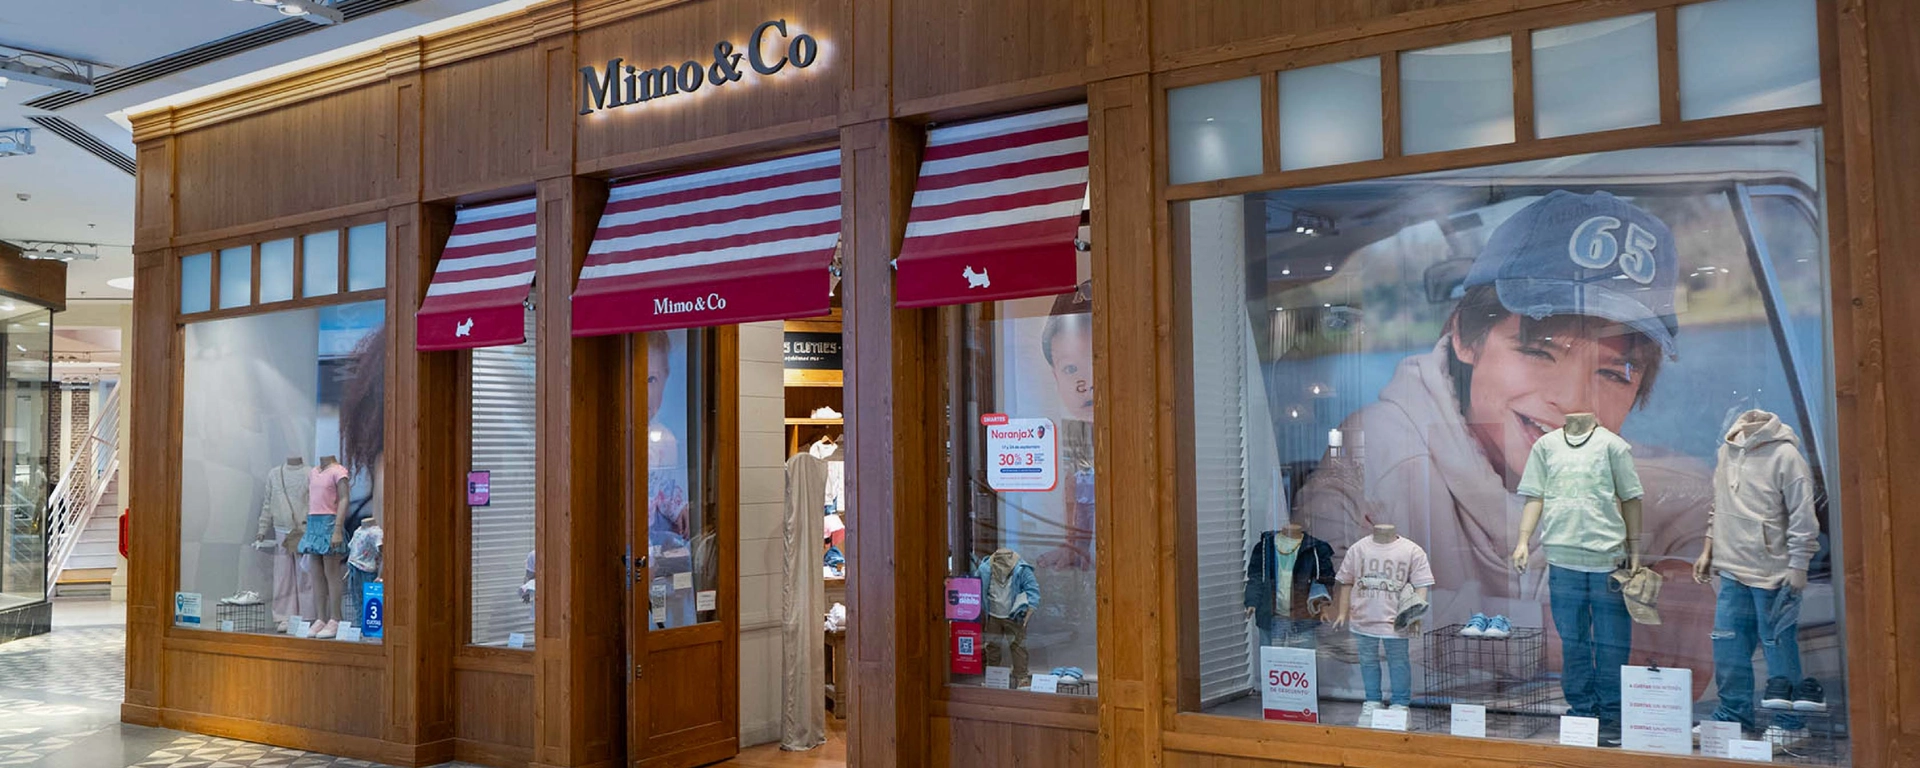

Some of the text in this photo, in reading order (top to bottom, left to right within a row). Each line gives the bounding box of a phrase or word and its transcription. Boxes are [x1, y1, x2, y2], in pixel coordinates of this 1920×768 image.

[1568, 215, 1657, 284] 65
[1026, 453, 1033, 466] 3
[1360, 558, 1407, 582] 1965
[948, 590, 959, 606] 5
[370, 606, 378, 620] 3
[1269, 670, 1309, 689] 50%
